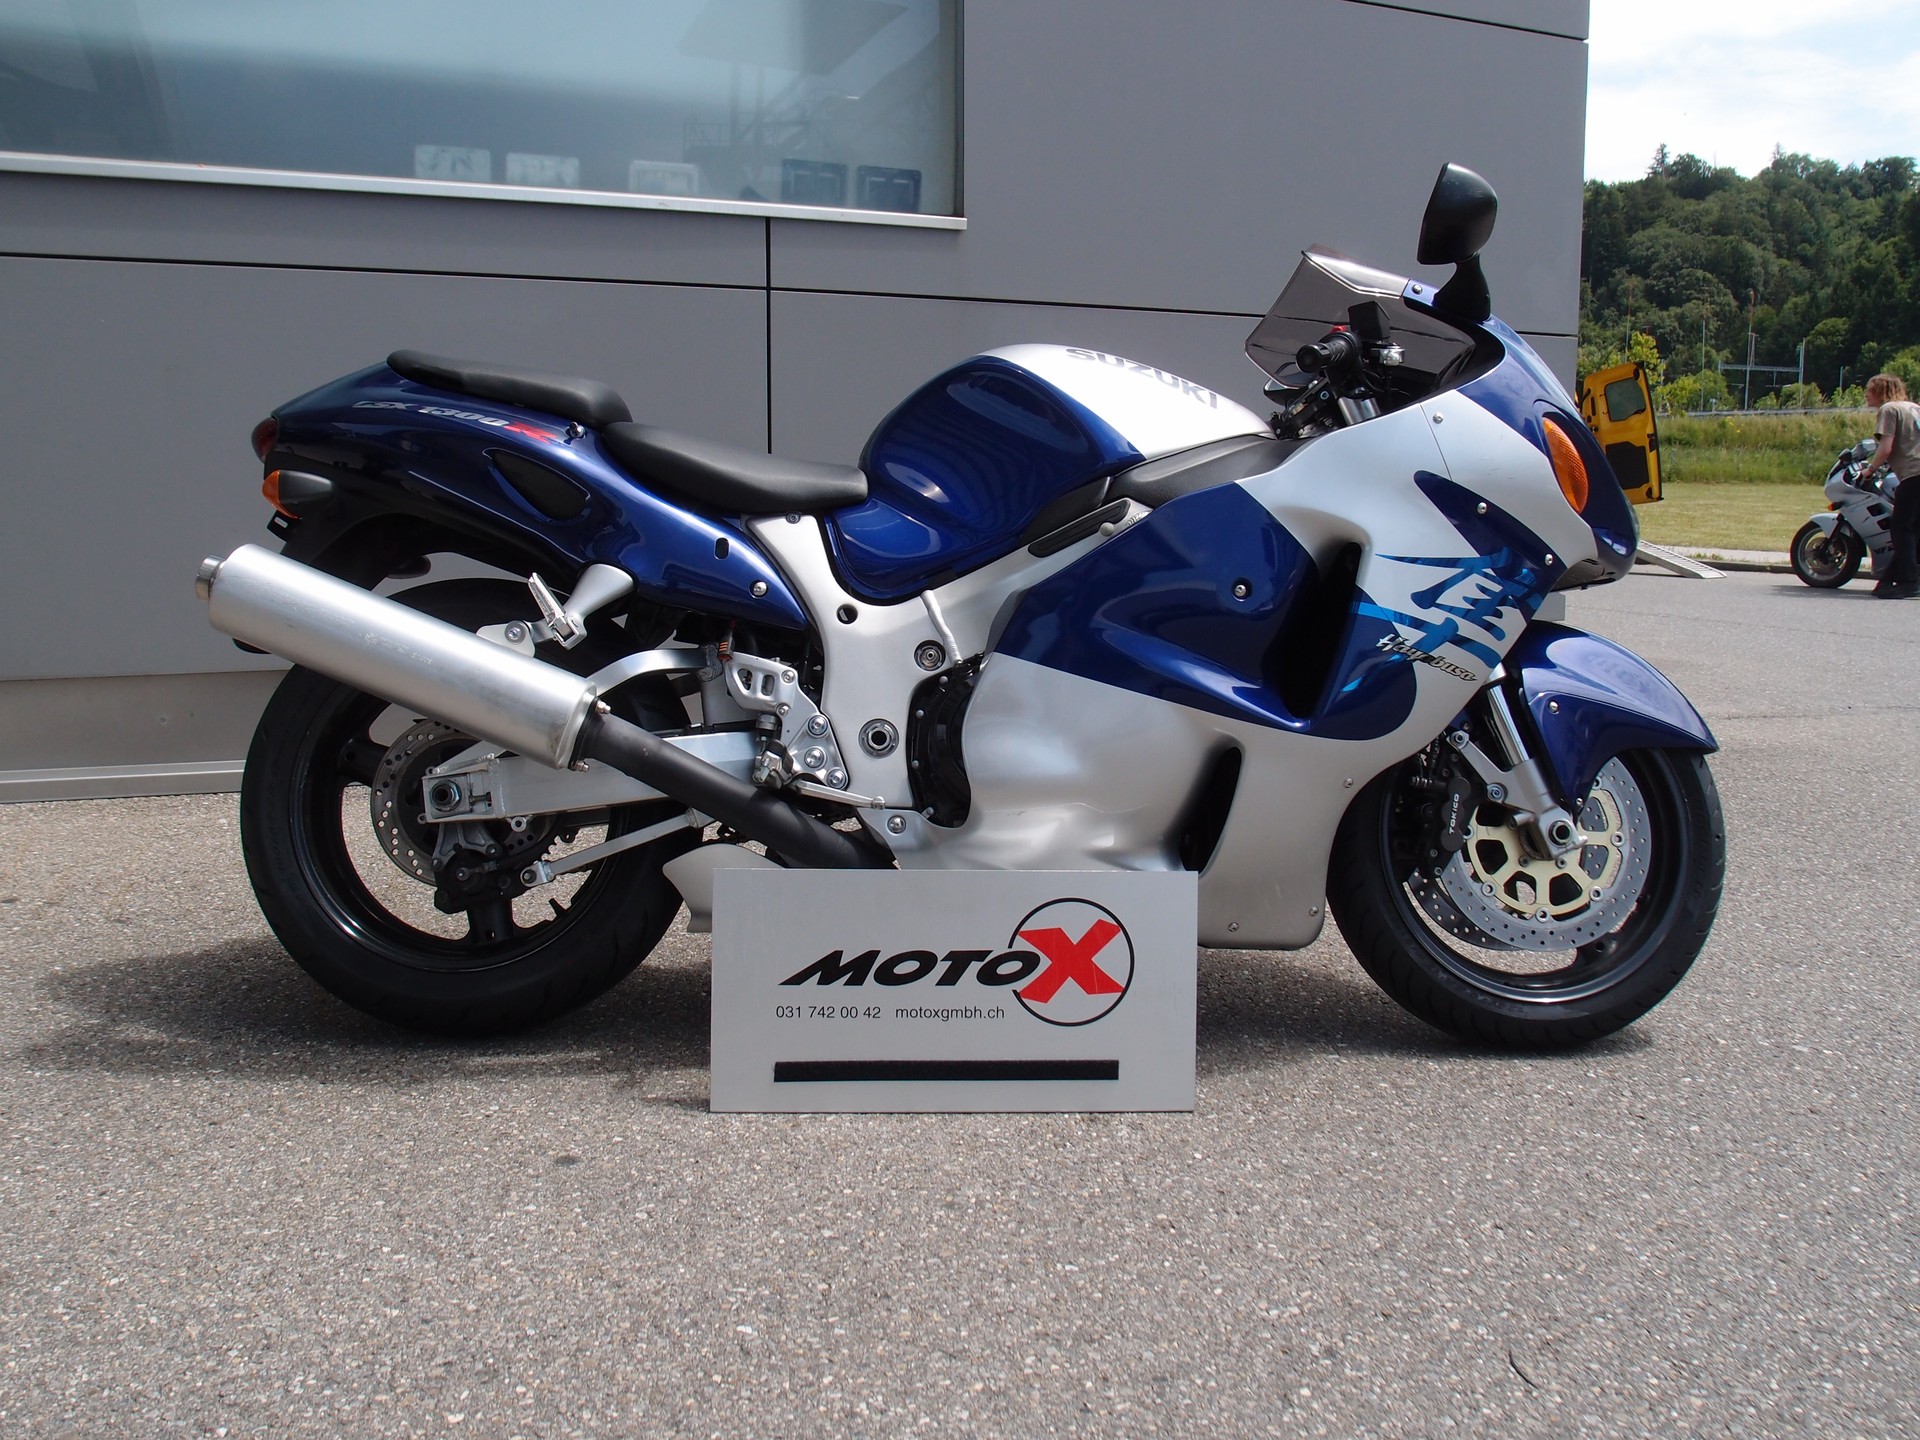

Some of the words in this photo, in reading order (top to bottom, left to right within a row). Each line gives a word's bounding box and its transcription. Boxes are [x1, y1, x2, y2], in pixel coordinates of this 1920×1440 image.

[1066, 348, 1218, 409] SUZUKI
[1376, 633, 1477, 681] Hayabusa
[1448, 793, 1460, 834] TOKICO
[775, 1005, 802, 1019] 031
[808, 1005, 836, 1019] 742
[840, 1005, 859, 1019] 00
[863, 1005, 882, 1019] 42
[895, 1005, 1006, 1022] motoxgmbh.ch
